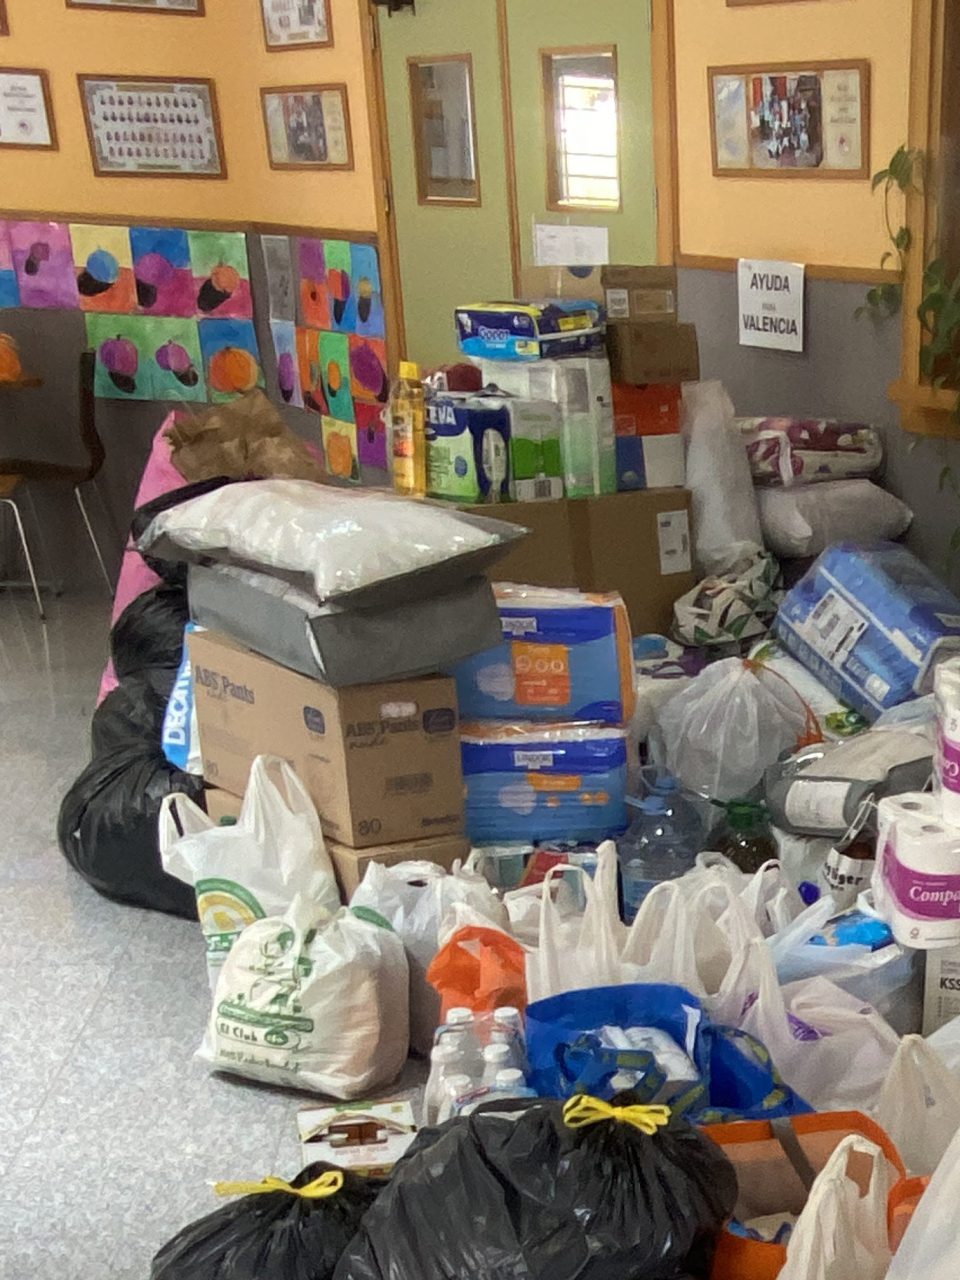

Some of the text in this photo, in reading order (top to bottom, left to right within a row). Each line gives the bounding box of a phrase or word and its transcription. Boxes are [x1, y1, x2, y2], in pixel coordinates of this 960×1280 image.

[750, 273, 791, 293] AYUDA
[743, 314, 798, 335] VALENCIA
[221, 675, 255, 705] Pants
[358, 818, 382, 836] 80
